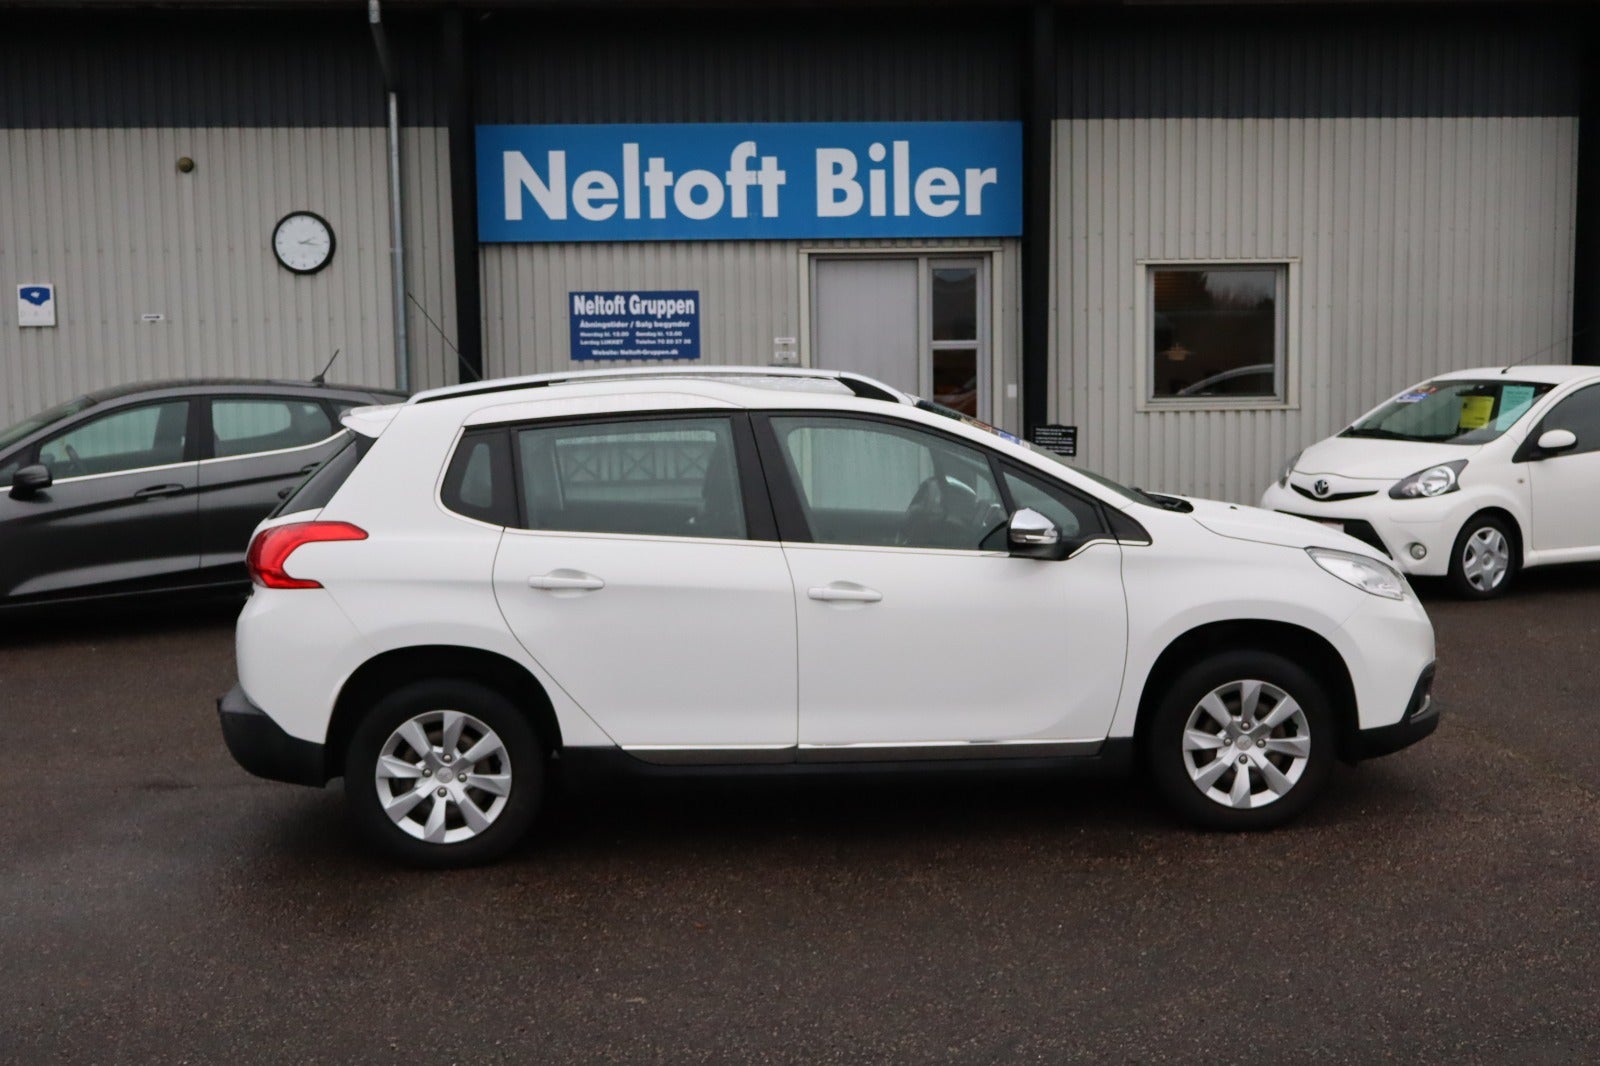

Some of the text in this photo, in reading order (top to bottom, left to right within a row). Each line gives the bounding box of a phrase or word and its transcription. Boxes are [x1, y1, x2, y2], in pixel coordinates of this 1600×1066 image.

[504, 141, 997, 221] Neltoft Biler
[574, 294, 695, 318] Neltoft Gruppen
